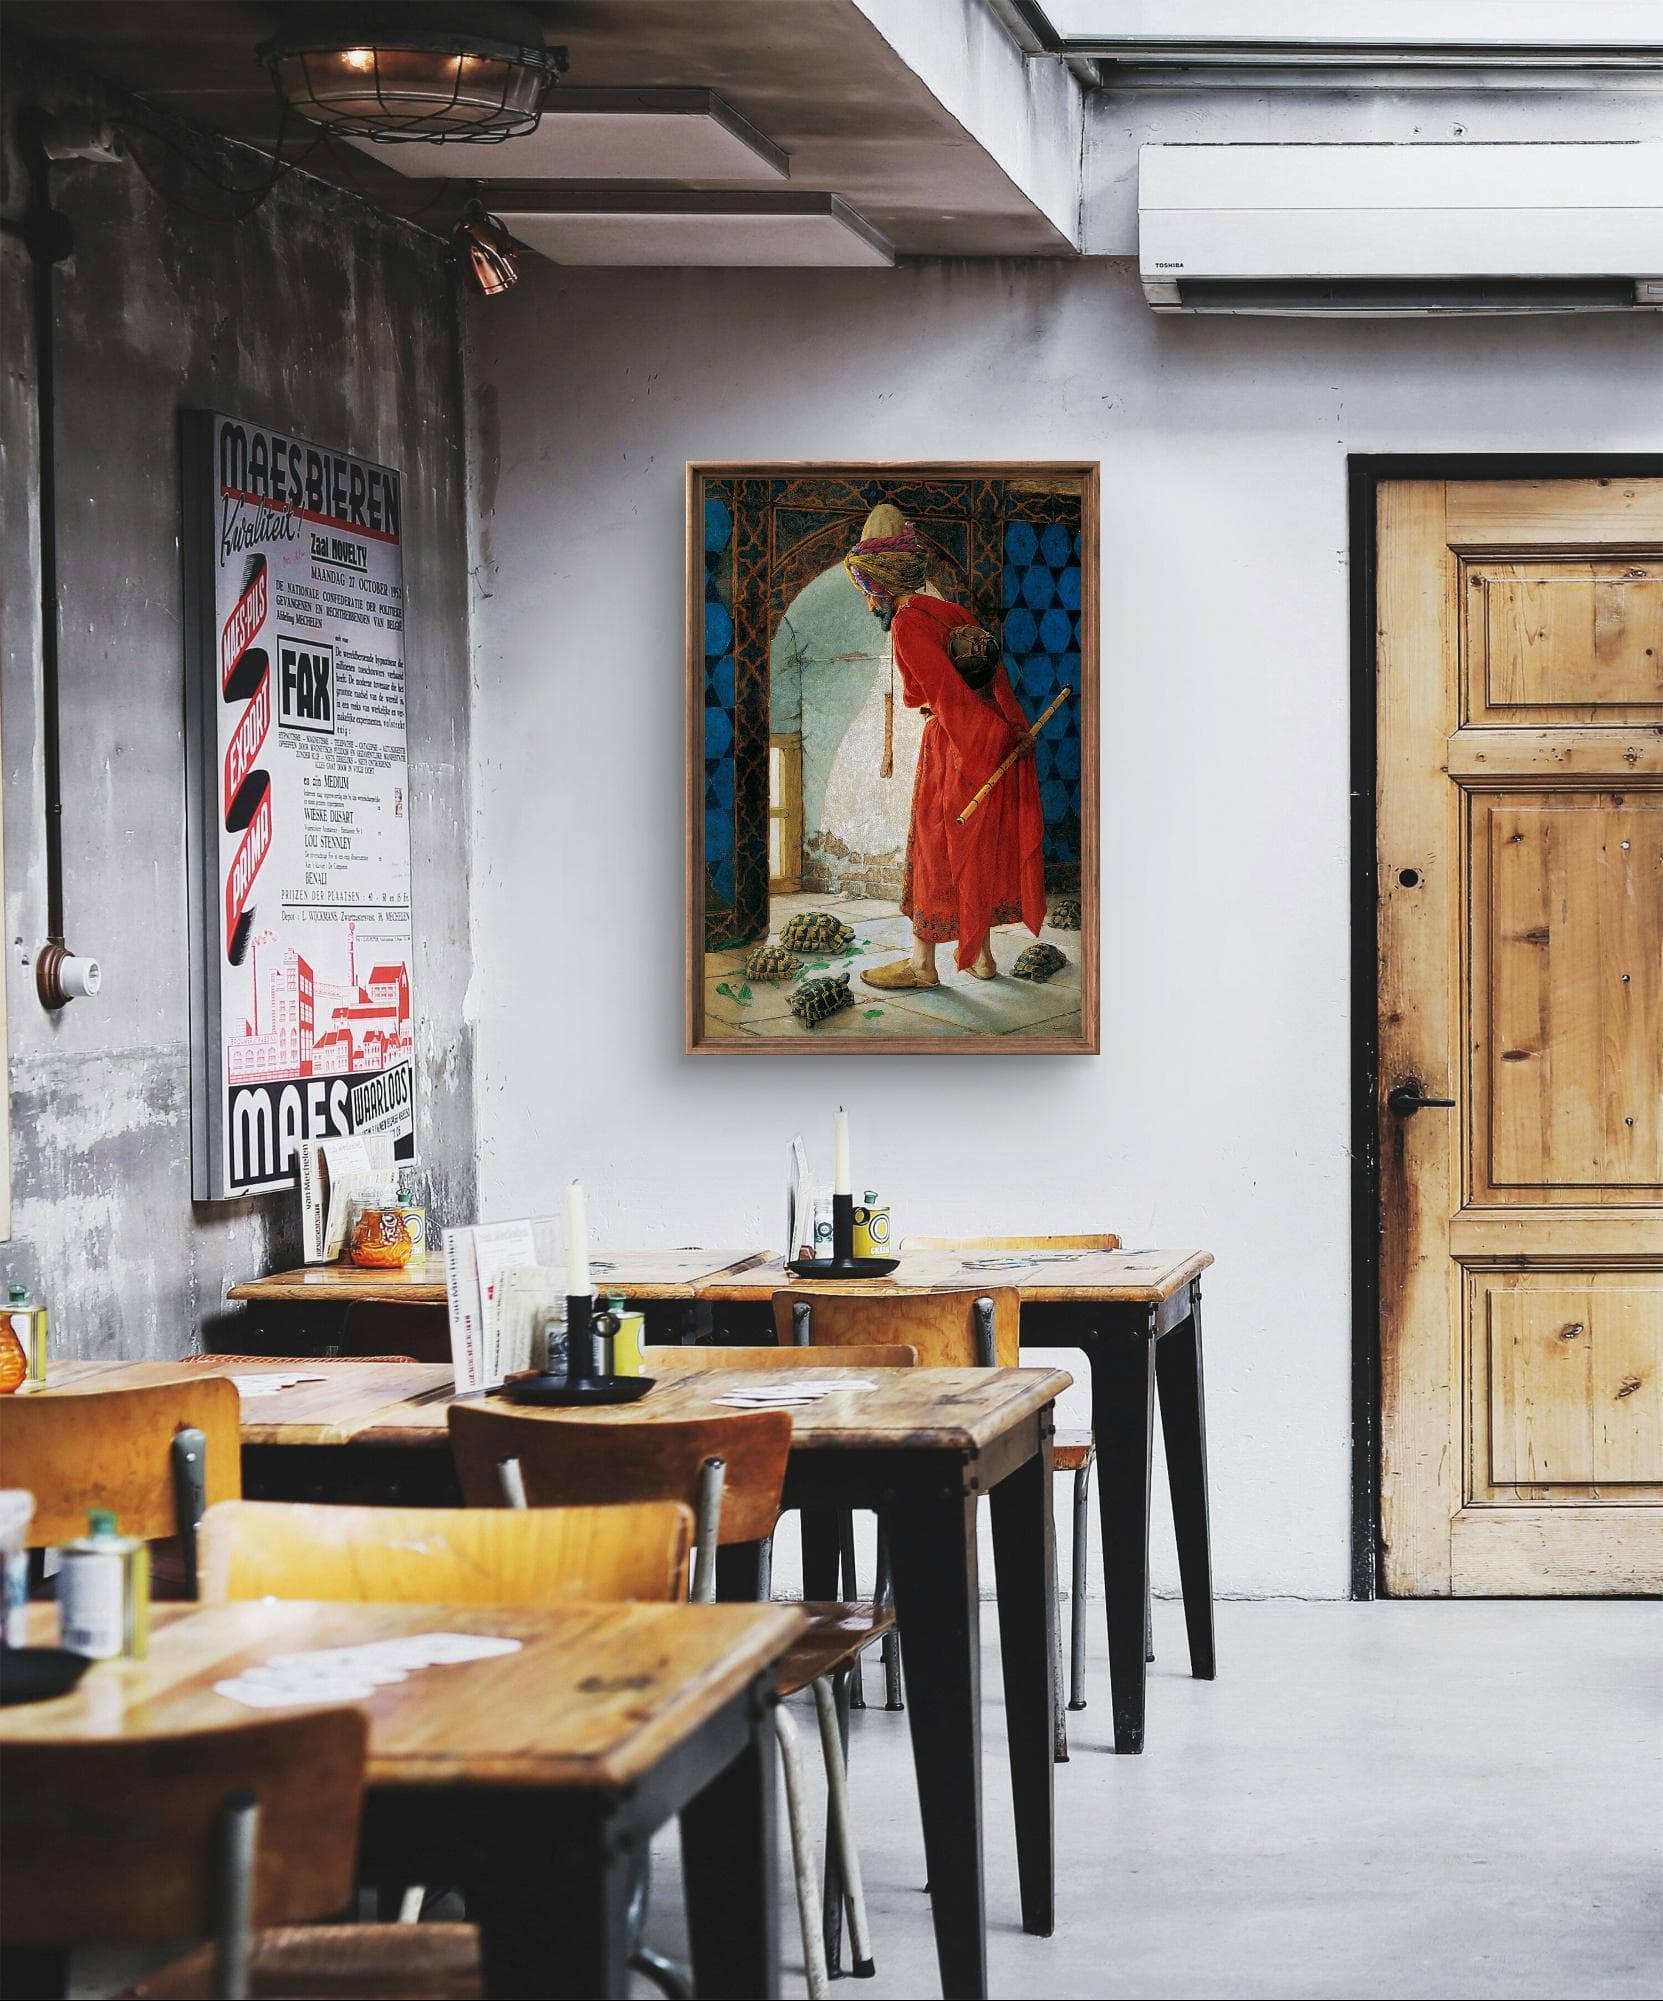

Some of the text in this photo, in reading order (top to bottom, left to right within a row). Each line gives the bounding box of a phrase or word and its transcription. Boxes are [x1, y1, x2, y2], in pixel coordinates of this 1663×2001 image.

[220, 421, 400, 535] MAESBIEREN
[311, 533, 329, 557] Zaal
[332, 538, 367, 567] NOVELTY
[276, 580, 284, 591] DE
[288, 582, 319, 599] NATIONALE
[323, 592, 363, 610] CONFEDERATIE
[366, 601, 376, 612] DER
[311, 566, 345, 586] MAANDAG
[349, 576, 355, 588] 27
[359, 578, 388, 596] OCTOBER
[276, 595, 311, 612] GEVANGENEN
[316, 604, 322, 614] EN
[374, 616, 384, 627] VAN
[296, 614, 322, 628] MECHELEN
[282, 649, 331, 721] FAX
[230, 677, 268, 796] EXPORT
[324, 775, 349, 789] MEDIUM
[304, 808, 353, 824] WIESKE DUSART
[305, 835, 318, 847] LOU
[232, 803, 268, 919] PRIMA
[312, 891, 324, 901] DER
[328, 891, 360, 901] PLAATSEN
[354, 1067, 407, 1126] WAARLOOS
[232, 1080, 350, 1180] MAES
